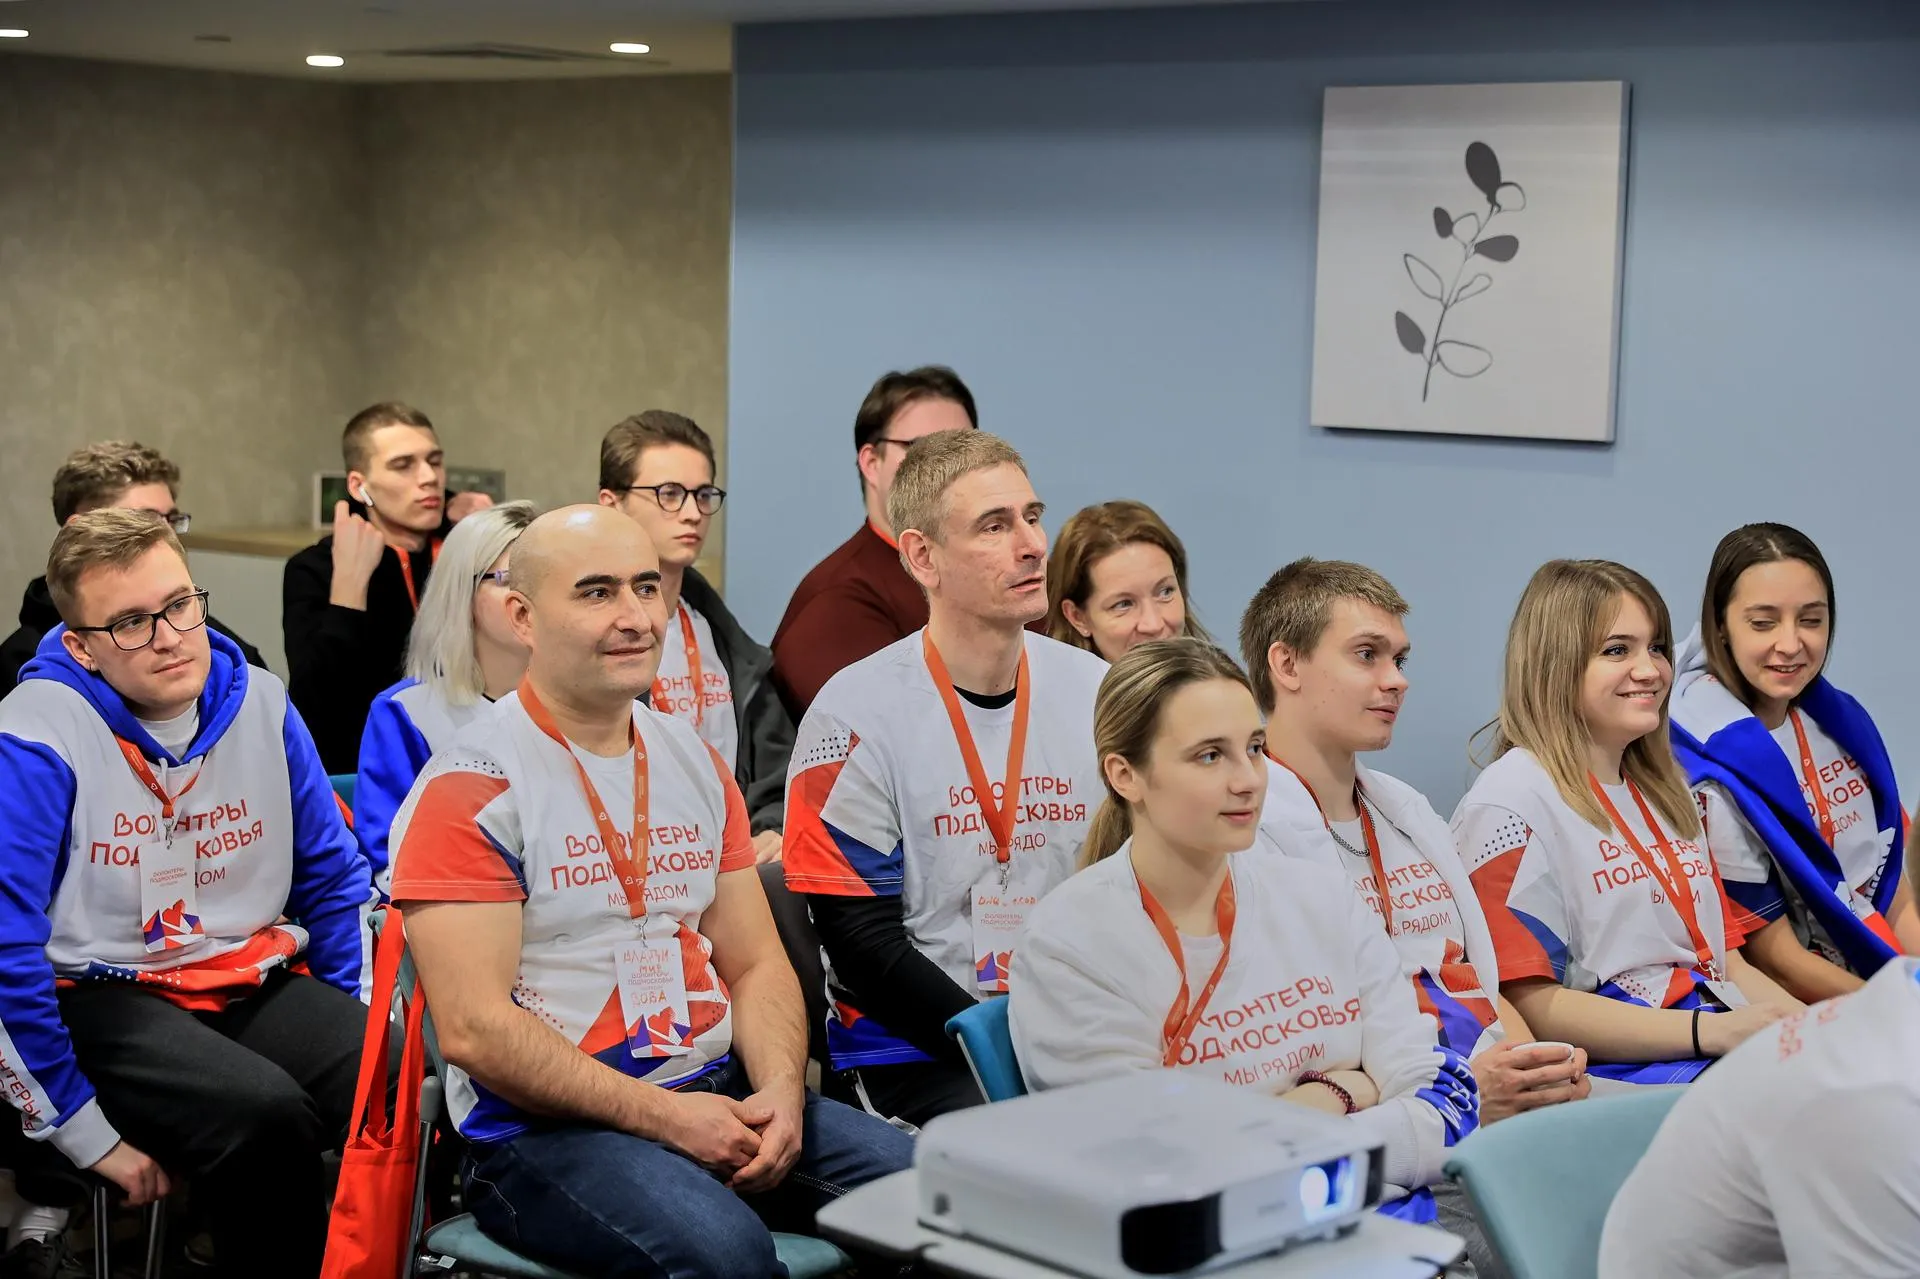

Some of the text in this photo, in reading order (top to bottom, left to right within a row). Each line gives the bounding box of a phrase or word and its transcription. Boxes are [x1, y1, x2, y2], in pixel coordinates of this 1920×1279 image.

[1402, 912, 1452, 935] РЯДОМ
[1177, 997, 1361, 1066] ОДМОСКОВЬЯ
[1224, 1041, 1325, 1087] МЫ РЯДОМ
